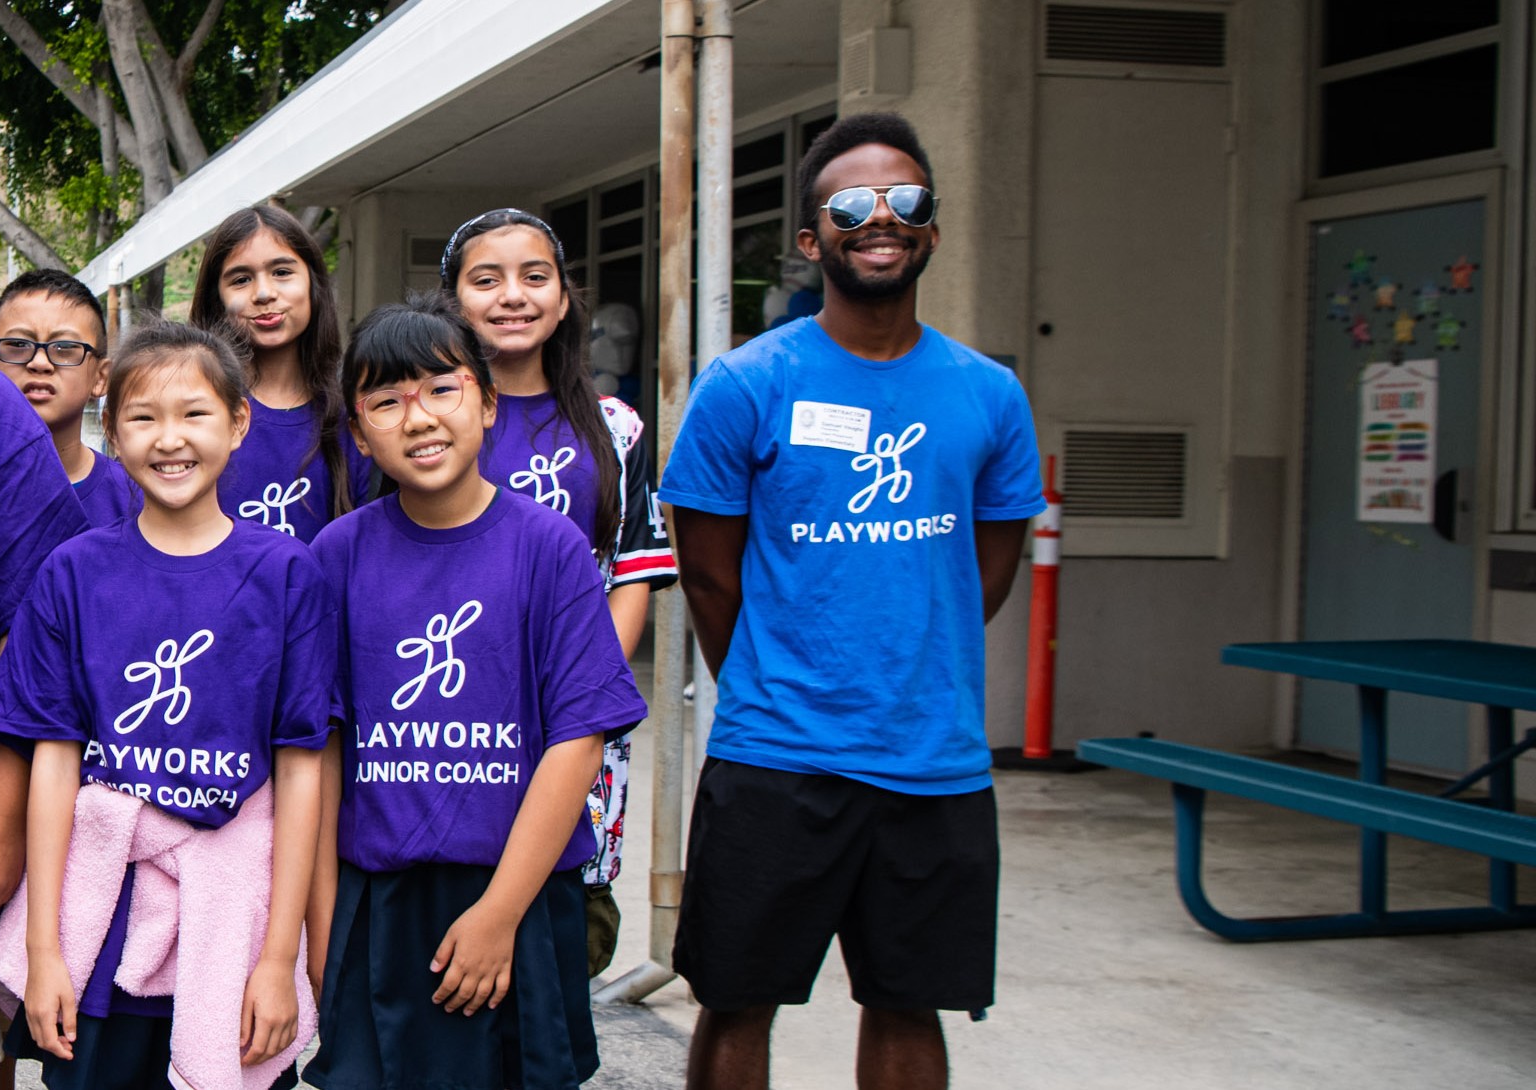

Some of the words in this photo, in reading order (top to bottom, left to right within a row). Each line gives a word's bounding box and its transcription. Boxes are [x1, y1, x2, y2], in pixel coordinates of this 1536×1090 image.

[791, 513, 957, 543] PLAYWORKS
[356, 721, 521, 749] LAYWORK
[434, 761, 520, 784] COACH
[156, 786, 237, 809] COACH
